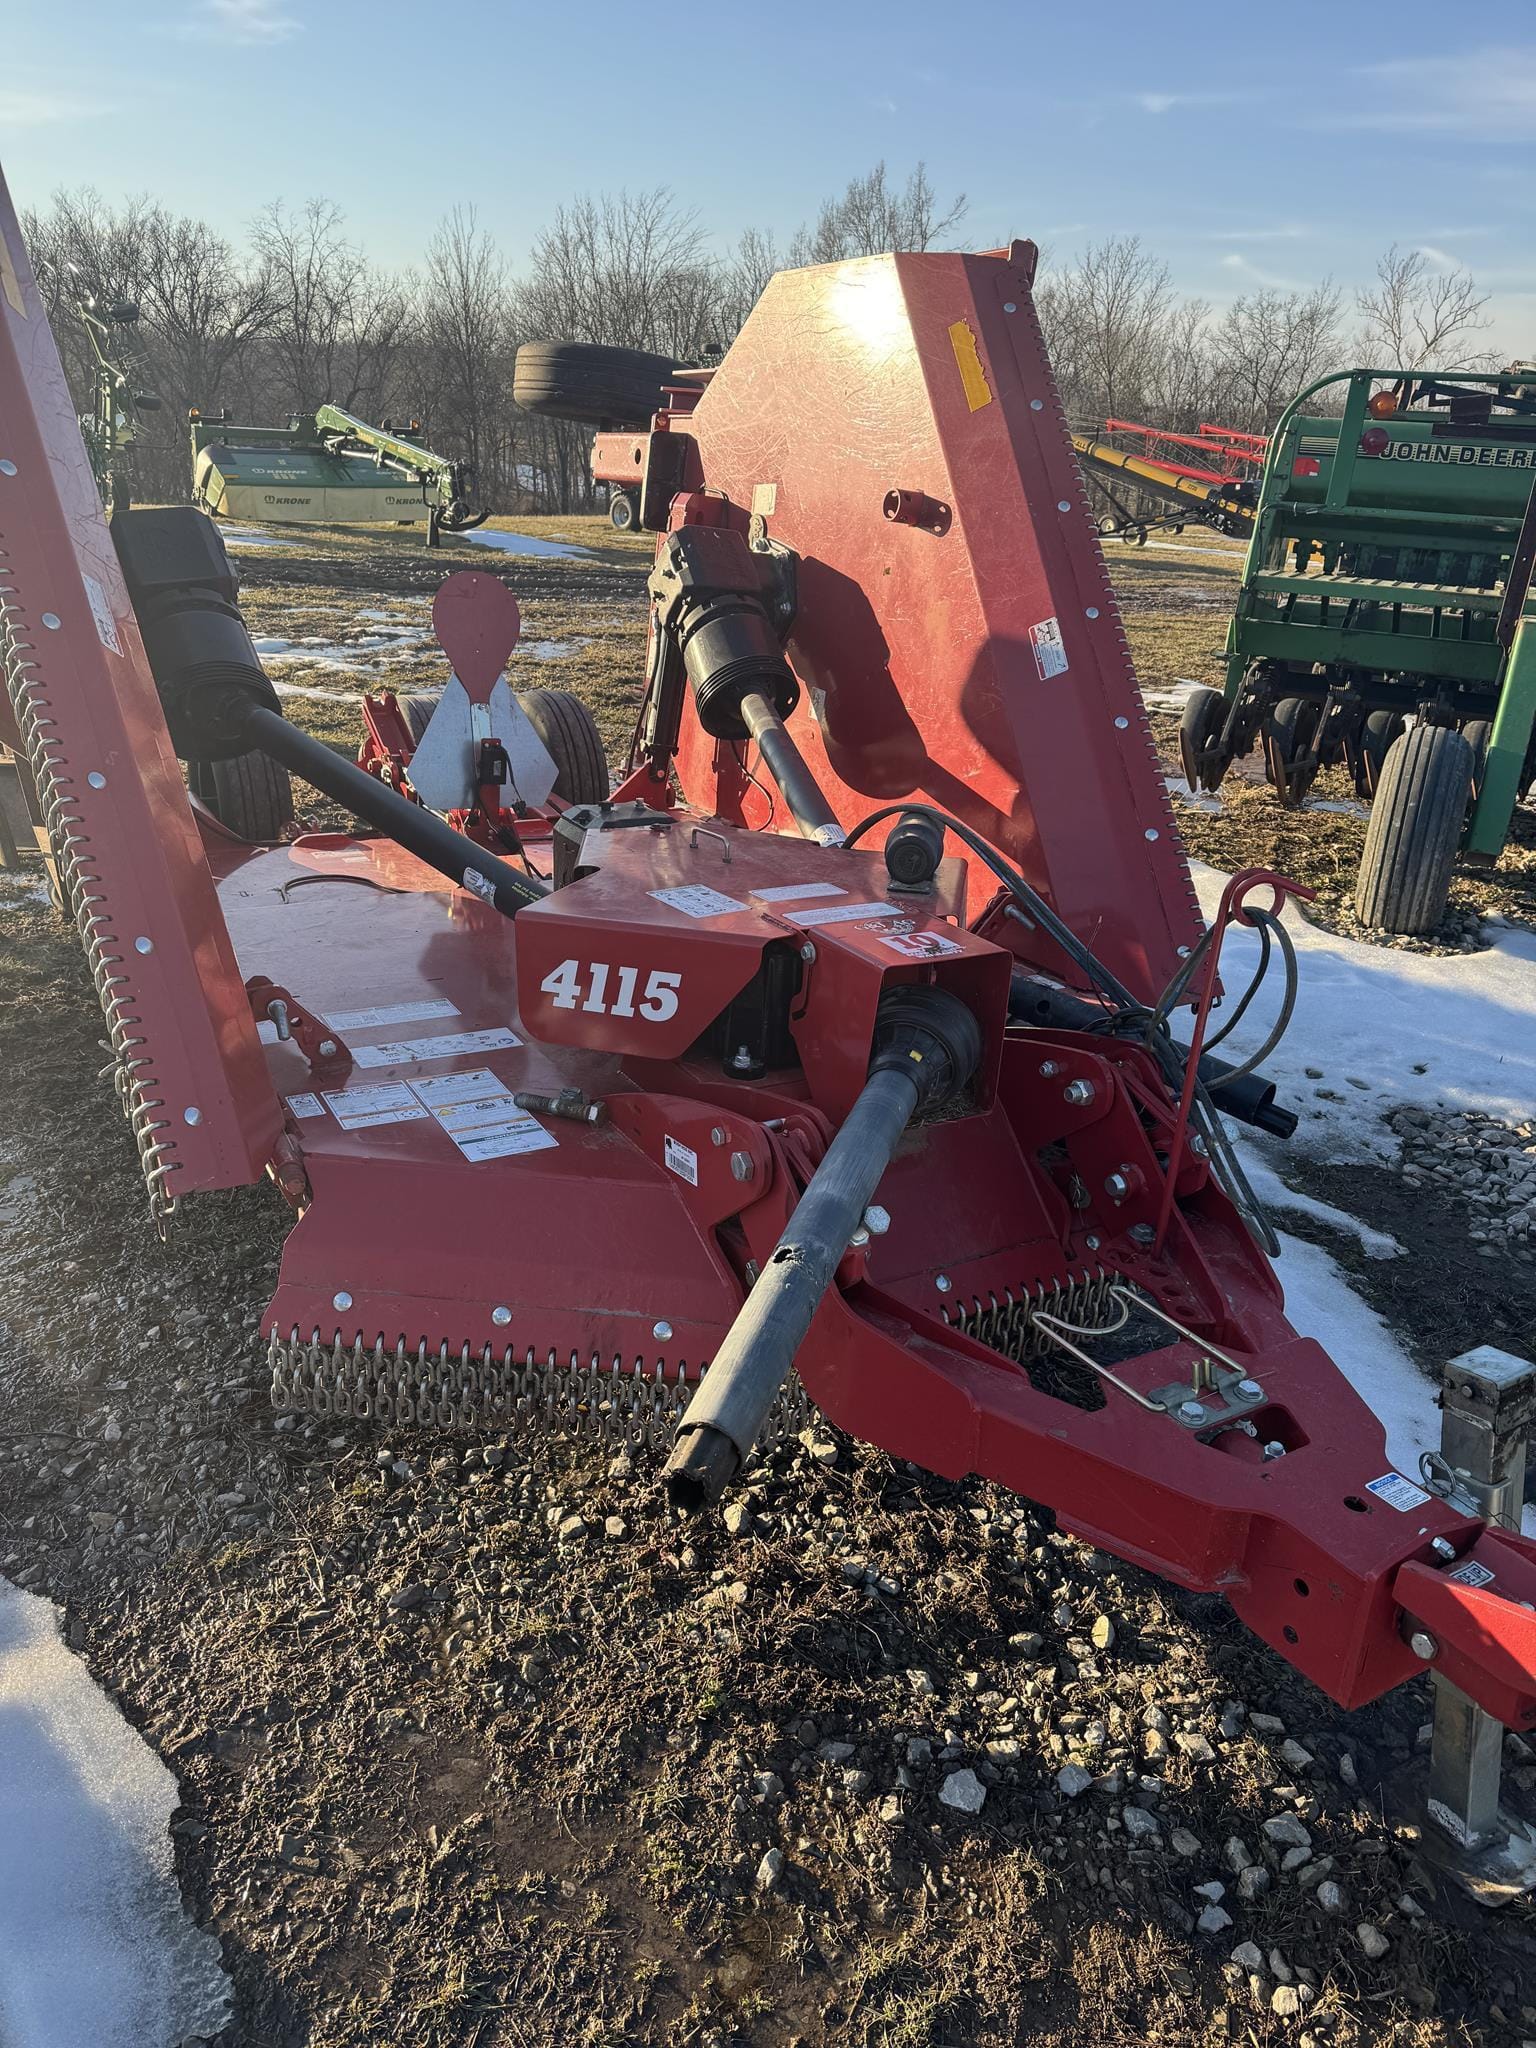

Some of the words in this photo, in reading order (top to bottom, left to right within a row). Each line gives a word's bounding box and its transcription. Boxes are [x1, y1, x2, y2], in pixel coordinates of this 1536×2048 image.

[1380, 441, 1450, 463] JOHN
[276, 497, 311, 505] KRONE
[891, 934, 940, 950] 10
[541, 960, 682, 1022] 4115
[1469, 1567, 1483, 1578] UP
